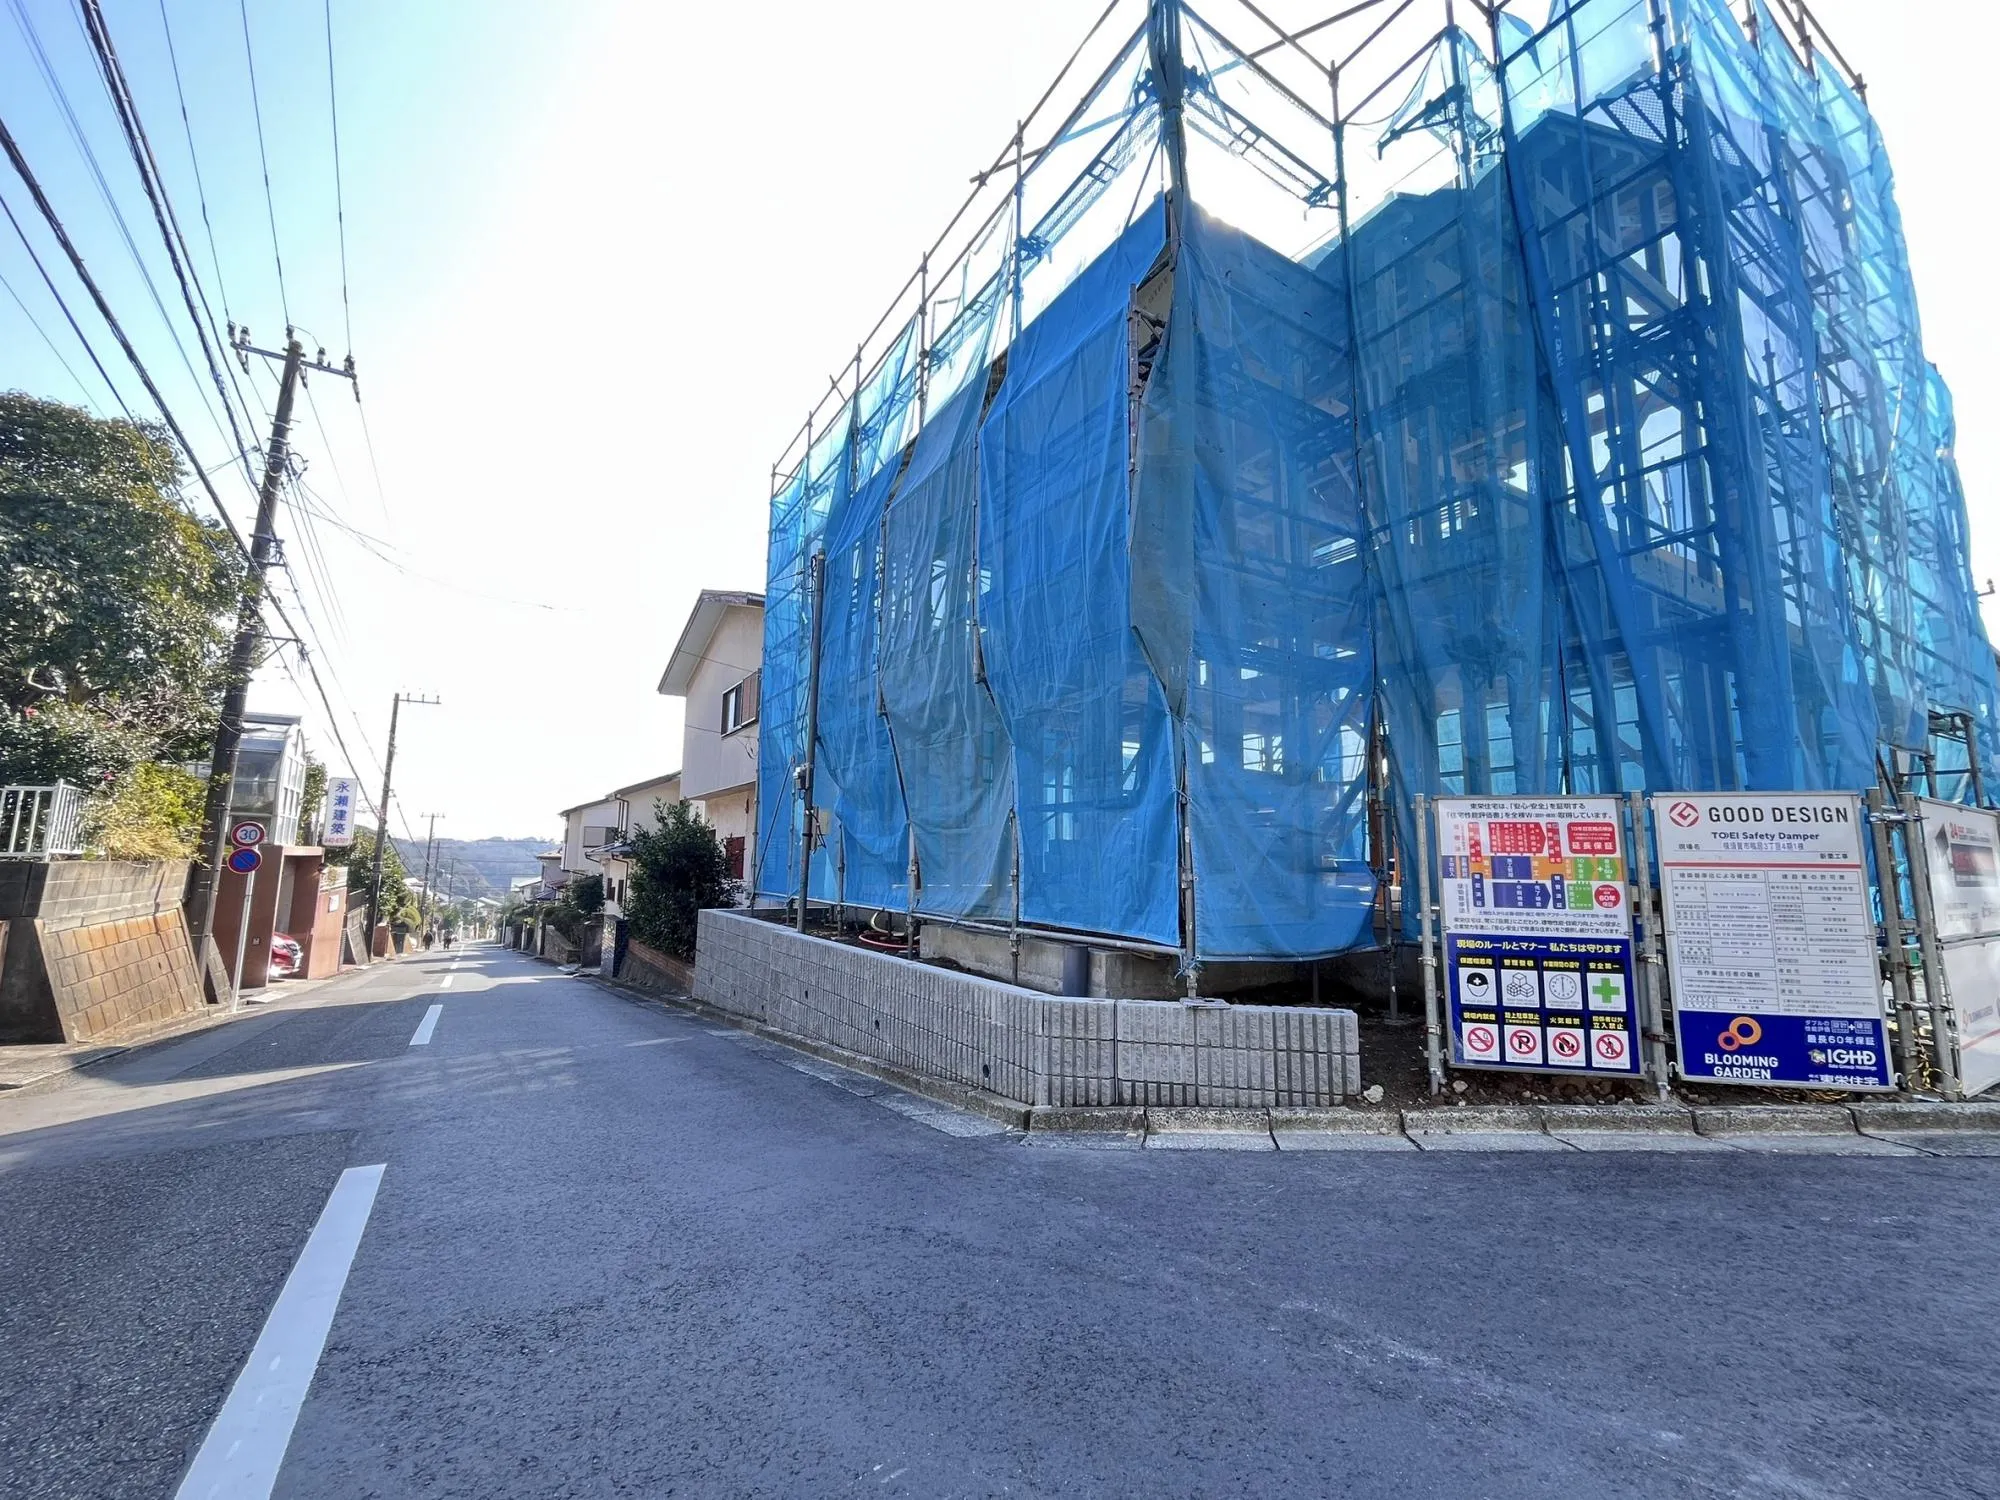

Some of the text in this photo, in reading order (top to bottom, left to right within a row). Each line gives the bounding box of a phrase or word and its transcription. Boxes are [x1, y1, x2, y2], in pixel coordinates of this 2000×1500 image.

[1708, 806, 1848, 823] GOOD DESIGN
[240, 829, 259, 841] 30
[1742, 831, 1776, 842] Safety
[1778, 831, 1820, 842] Damper
[1456, 939, 1622, 953] 現場のルールとマナー 私たちは守ります
[1549, 1017, 1580, 1025] 火気厳禁
[1593, 1022, 1624, 1030] 立入禁止
[1807, 1034, 1875, 1046] 最長60年保証
[1704, 1052, 1779, 1068] BLOOMING
[1713, 1066, 1771, 1080] GARDEN
